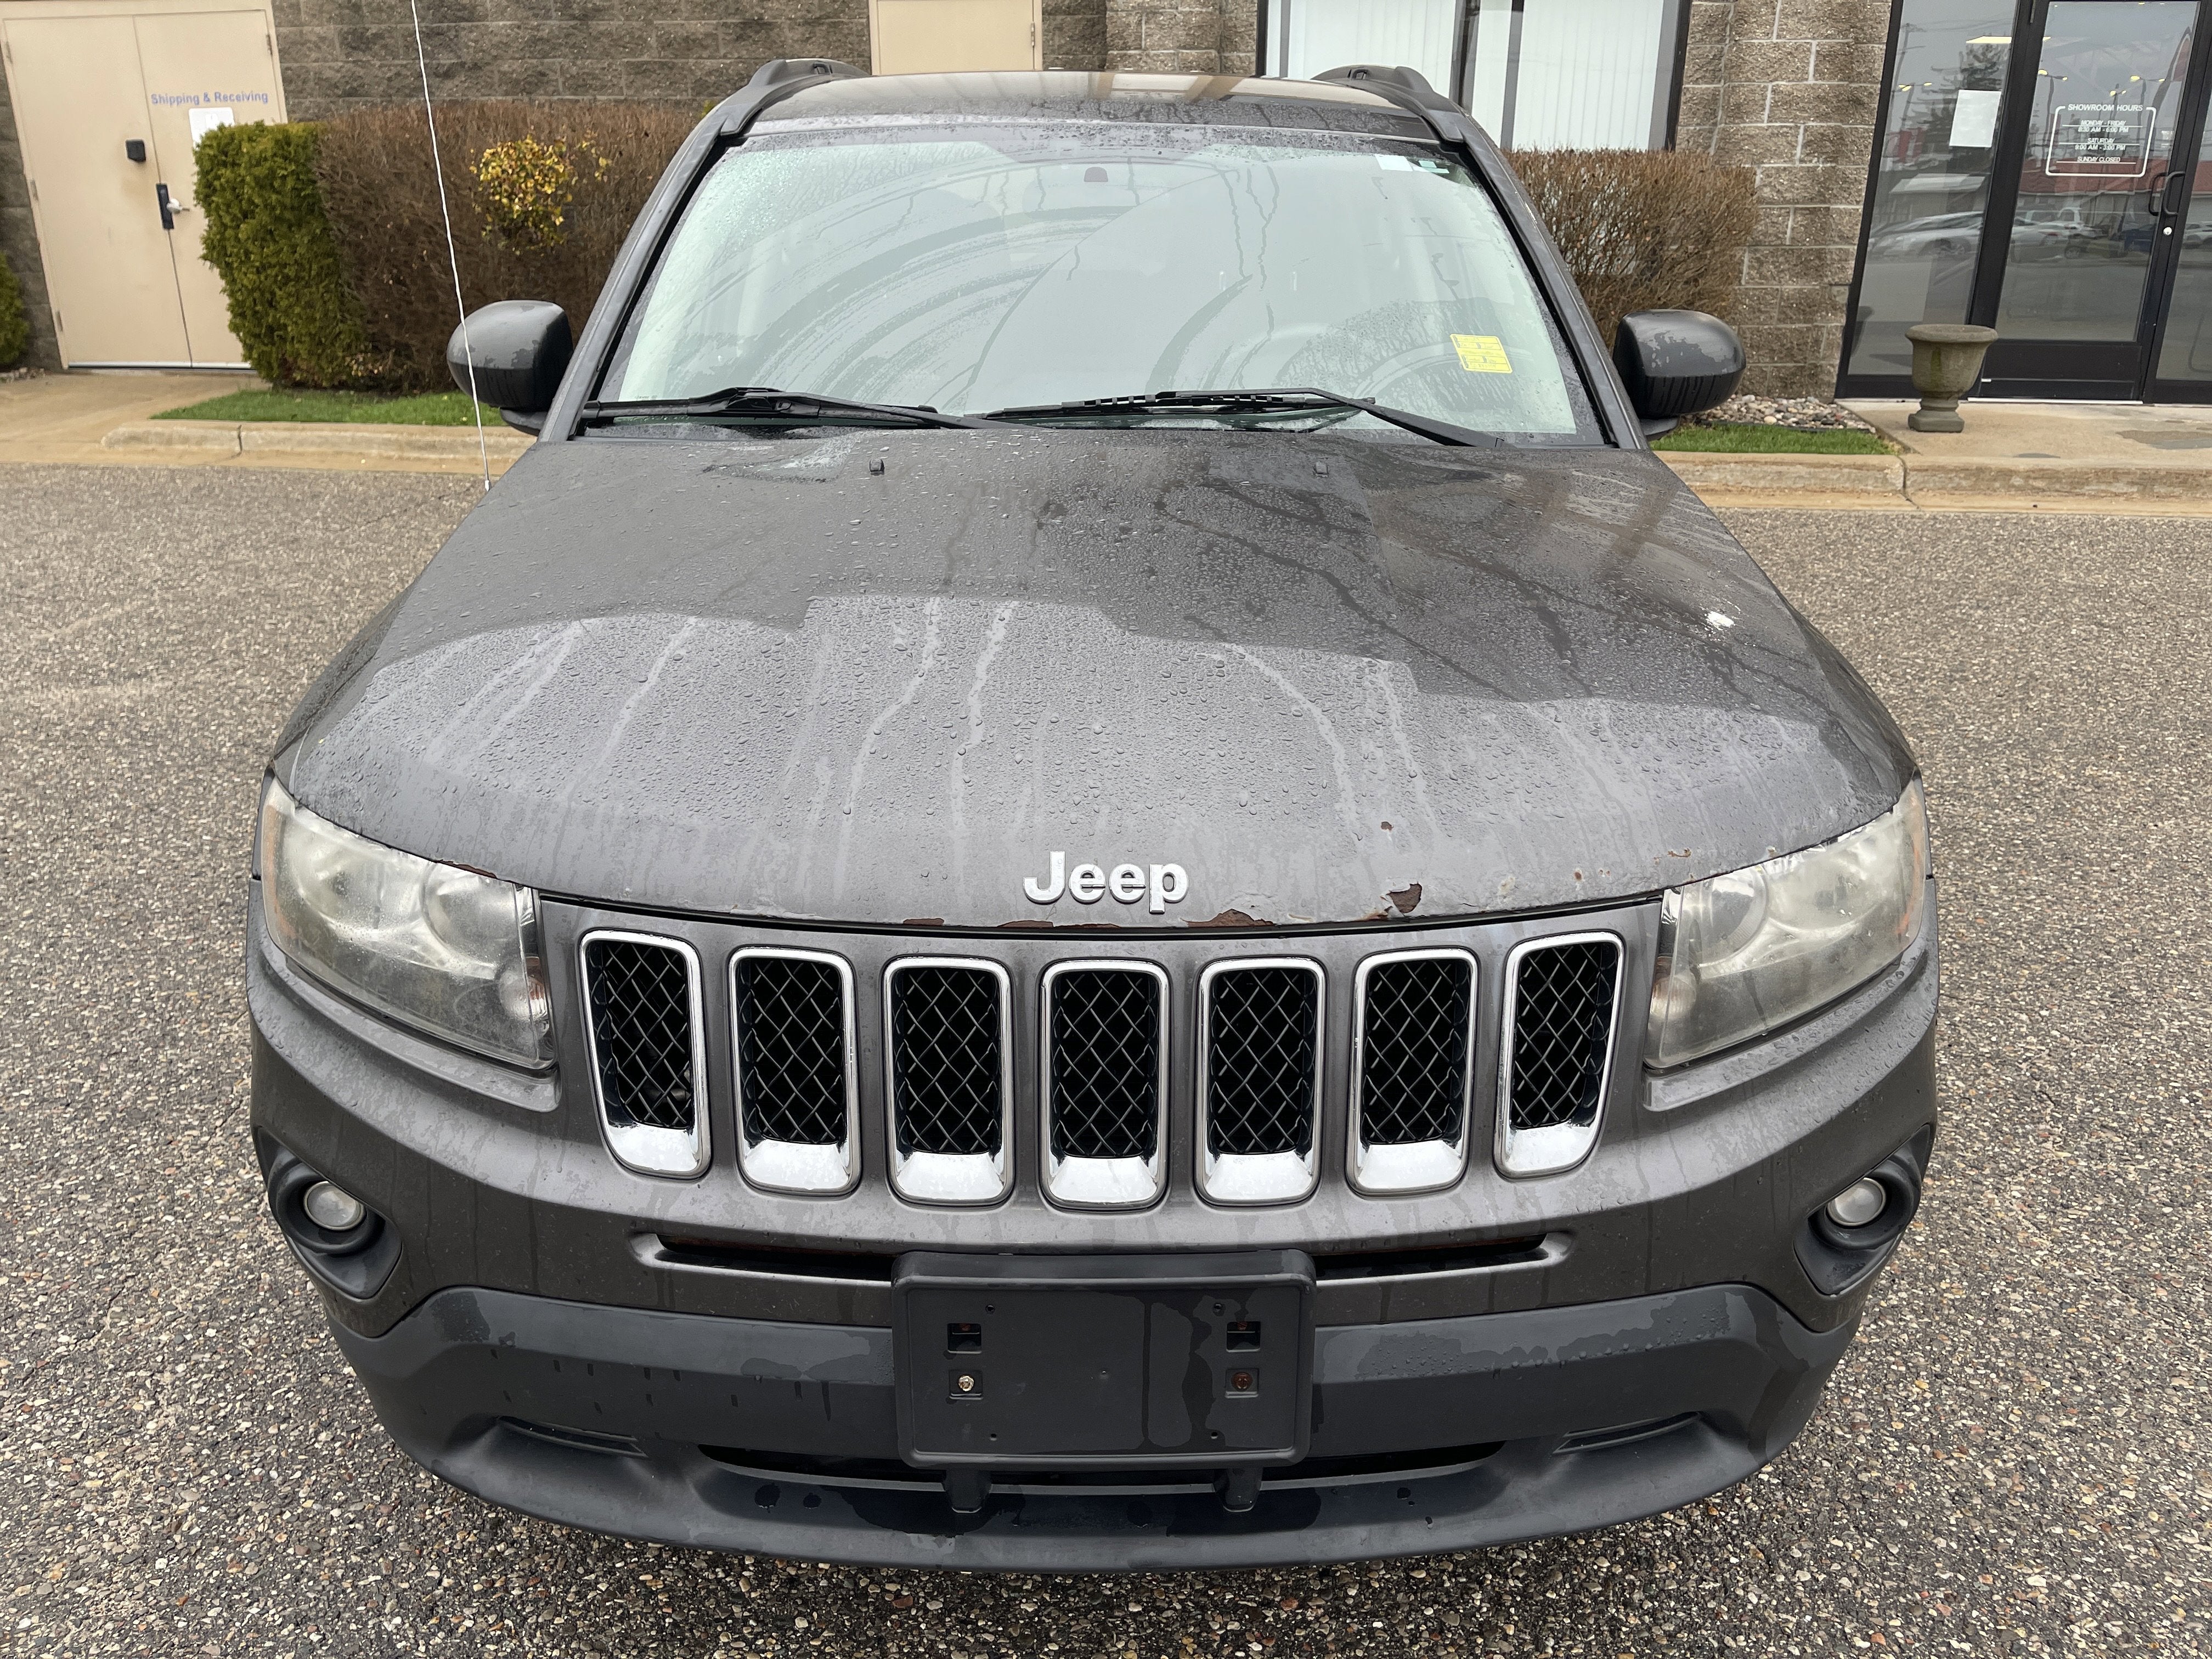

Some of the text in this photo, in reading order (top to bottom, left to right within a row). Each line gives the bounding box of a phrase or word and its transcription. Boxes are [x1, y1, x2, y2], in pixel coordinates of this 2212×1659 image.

[151, 91, 268, 105] Shipping & Receiving
[1023, 851, 1189, 914] Jeep
